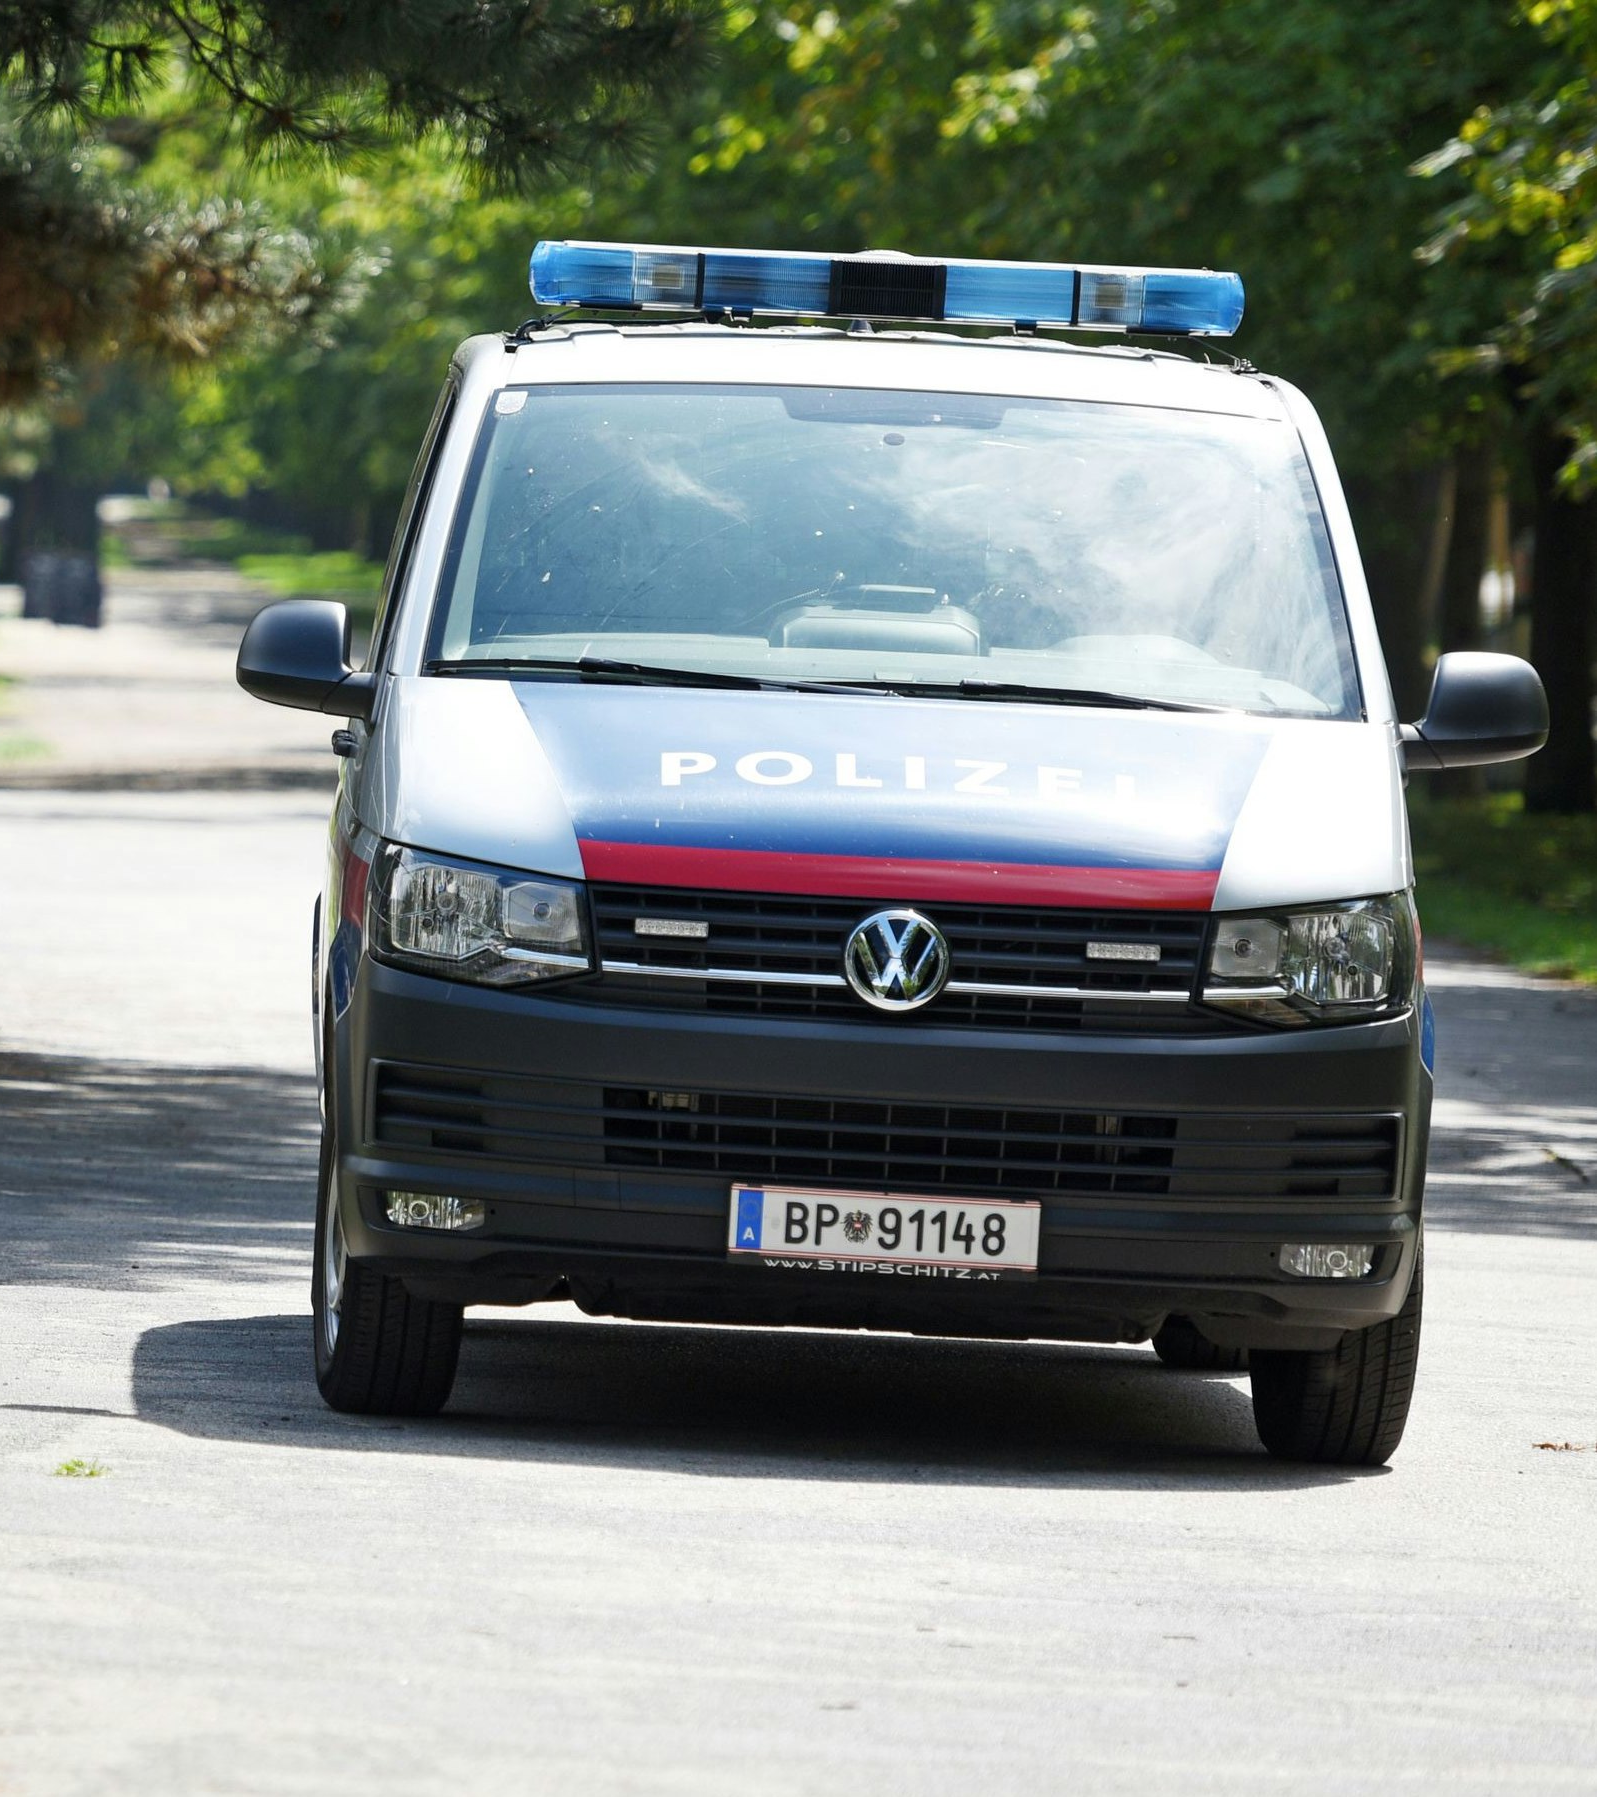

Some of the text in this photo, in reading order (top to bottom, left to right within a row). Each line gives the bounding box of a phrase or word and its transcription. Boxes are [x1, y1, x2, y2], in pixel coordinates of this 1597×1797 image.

[660, 751, 1137, 802] POLIZEI
[743, 1226, 755, 1241] A
[784, 1202, 1007, 1256] BP 91148
